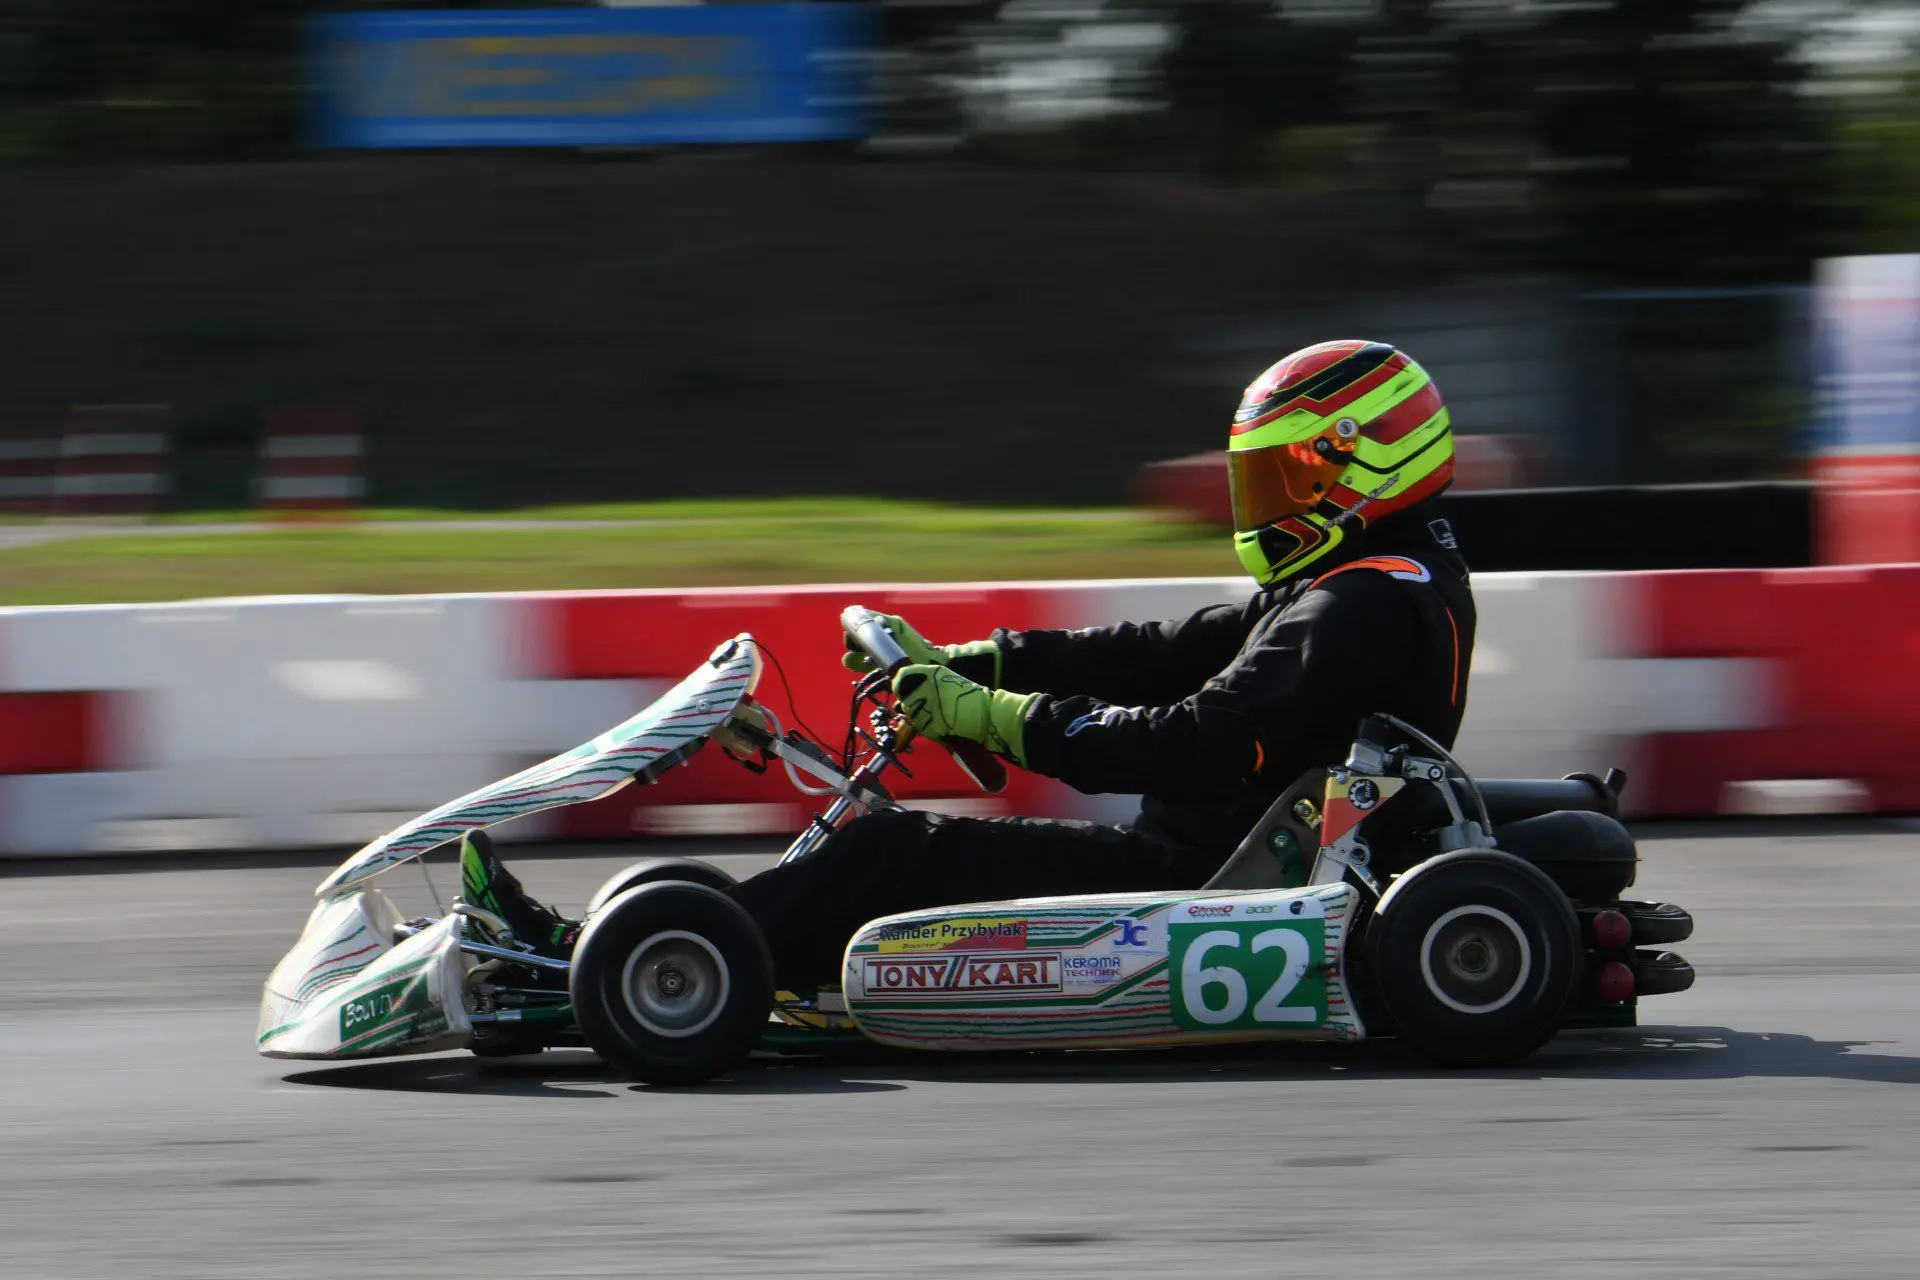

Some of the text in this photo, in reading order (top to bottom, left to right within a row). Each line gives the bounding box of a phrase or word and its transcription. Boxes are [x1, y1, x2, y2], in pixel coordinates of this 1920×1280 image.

[1245, 905, 1279, 914] acer
[941, 923, 1022, 940] Przybylak
[969, 957, 1058, 986] KART
[1064, 957, 1120, 969] KEROMA
[1181, 928, 1317, 1025] 62
